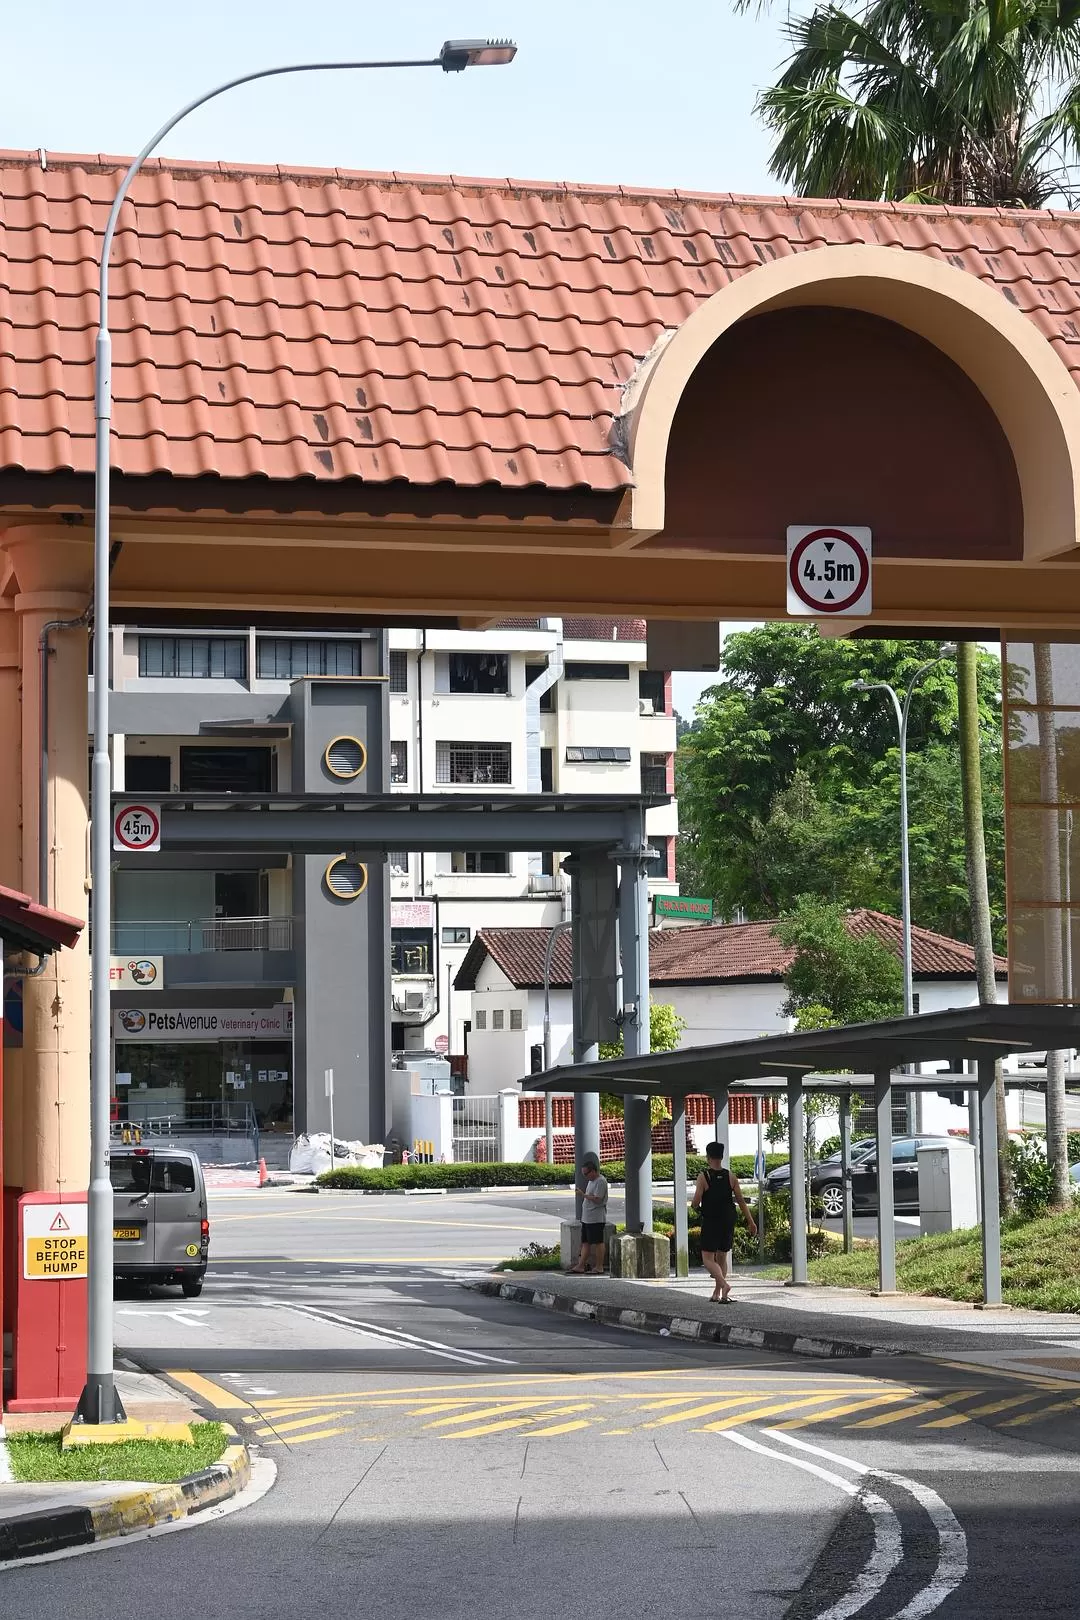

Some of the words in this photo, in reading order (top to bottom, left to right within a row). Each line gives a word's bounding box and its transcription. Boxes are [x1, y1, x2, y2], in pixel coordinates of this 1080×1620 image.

[804, 559, 855, 581] 4.5m
[123, 820, 151, 835] 4.5m
[109, 968, 125, 980] ET
[148, 1012, 217, 1030] PetsAvenue
[221, 1019, 258, 1031] Veterinary
[260, 1017, 280, 1029] Clinic
[114, 1230, 136, 1238] 728M
[44, 1239, 77, 1250] STOP
[36, 1251, 85, 1261] BEFORE
[43, 1262, 78, 1273] HUMP
